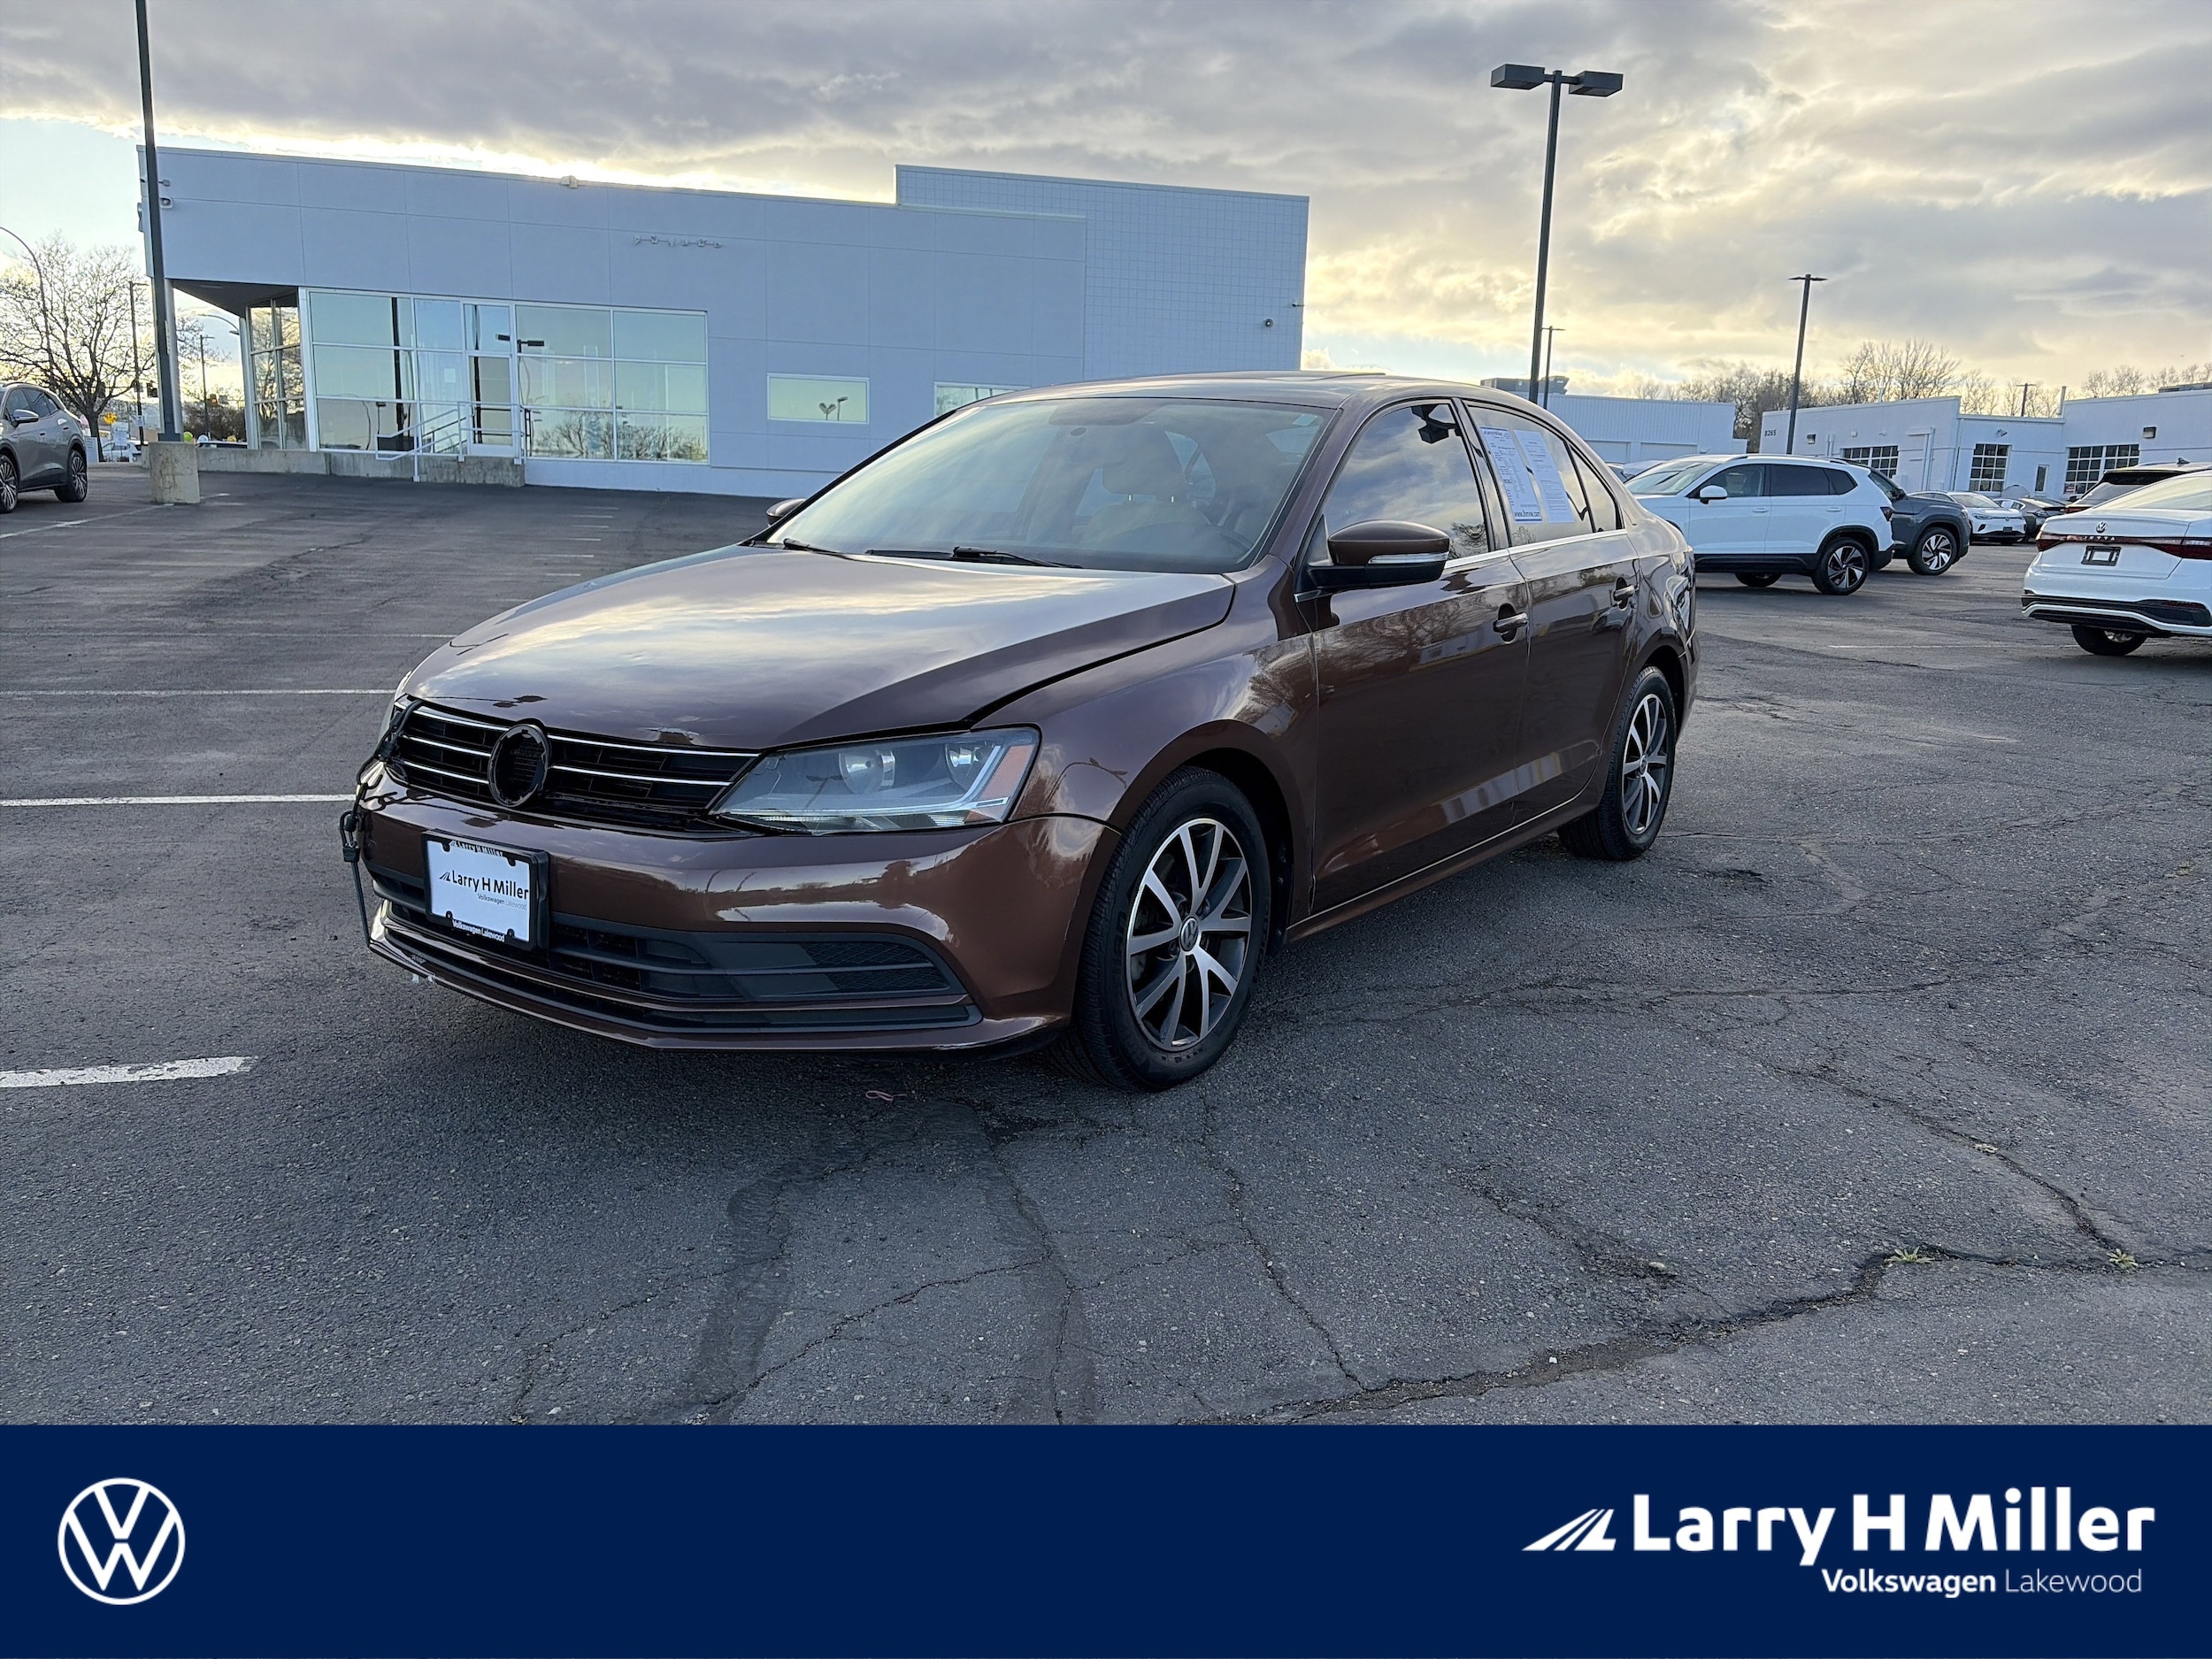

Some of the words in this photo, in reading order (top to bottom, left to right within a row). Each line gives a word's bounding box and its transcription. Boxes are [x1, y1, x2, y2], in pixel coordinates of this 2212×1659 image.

[452, 870, 480, 892] Larry
[481, 877, 491, 892] H
[493, 879, 529, 900] Miller
[478, 893, 505, 905] Volkswagen
[505, 899, 526, 910] Lakewood
[452, 918, 481, 935] Volkswagen
[481, 927, 505, 943] Lakewood
